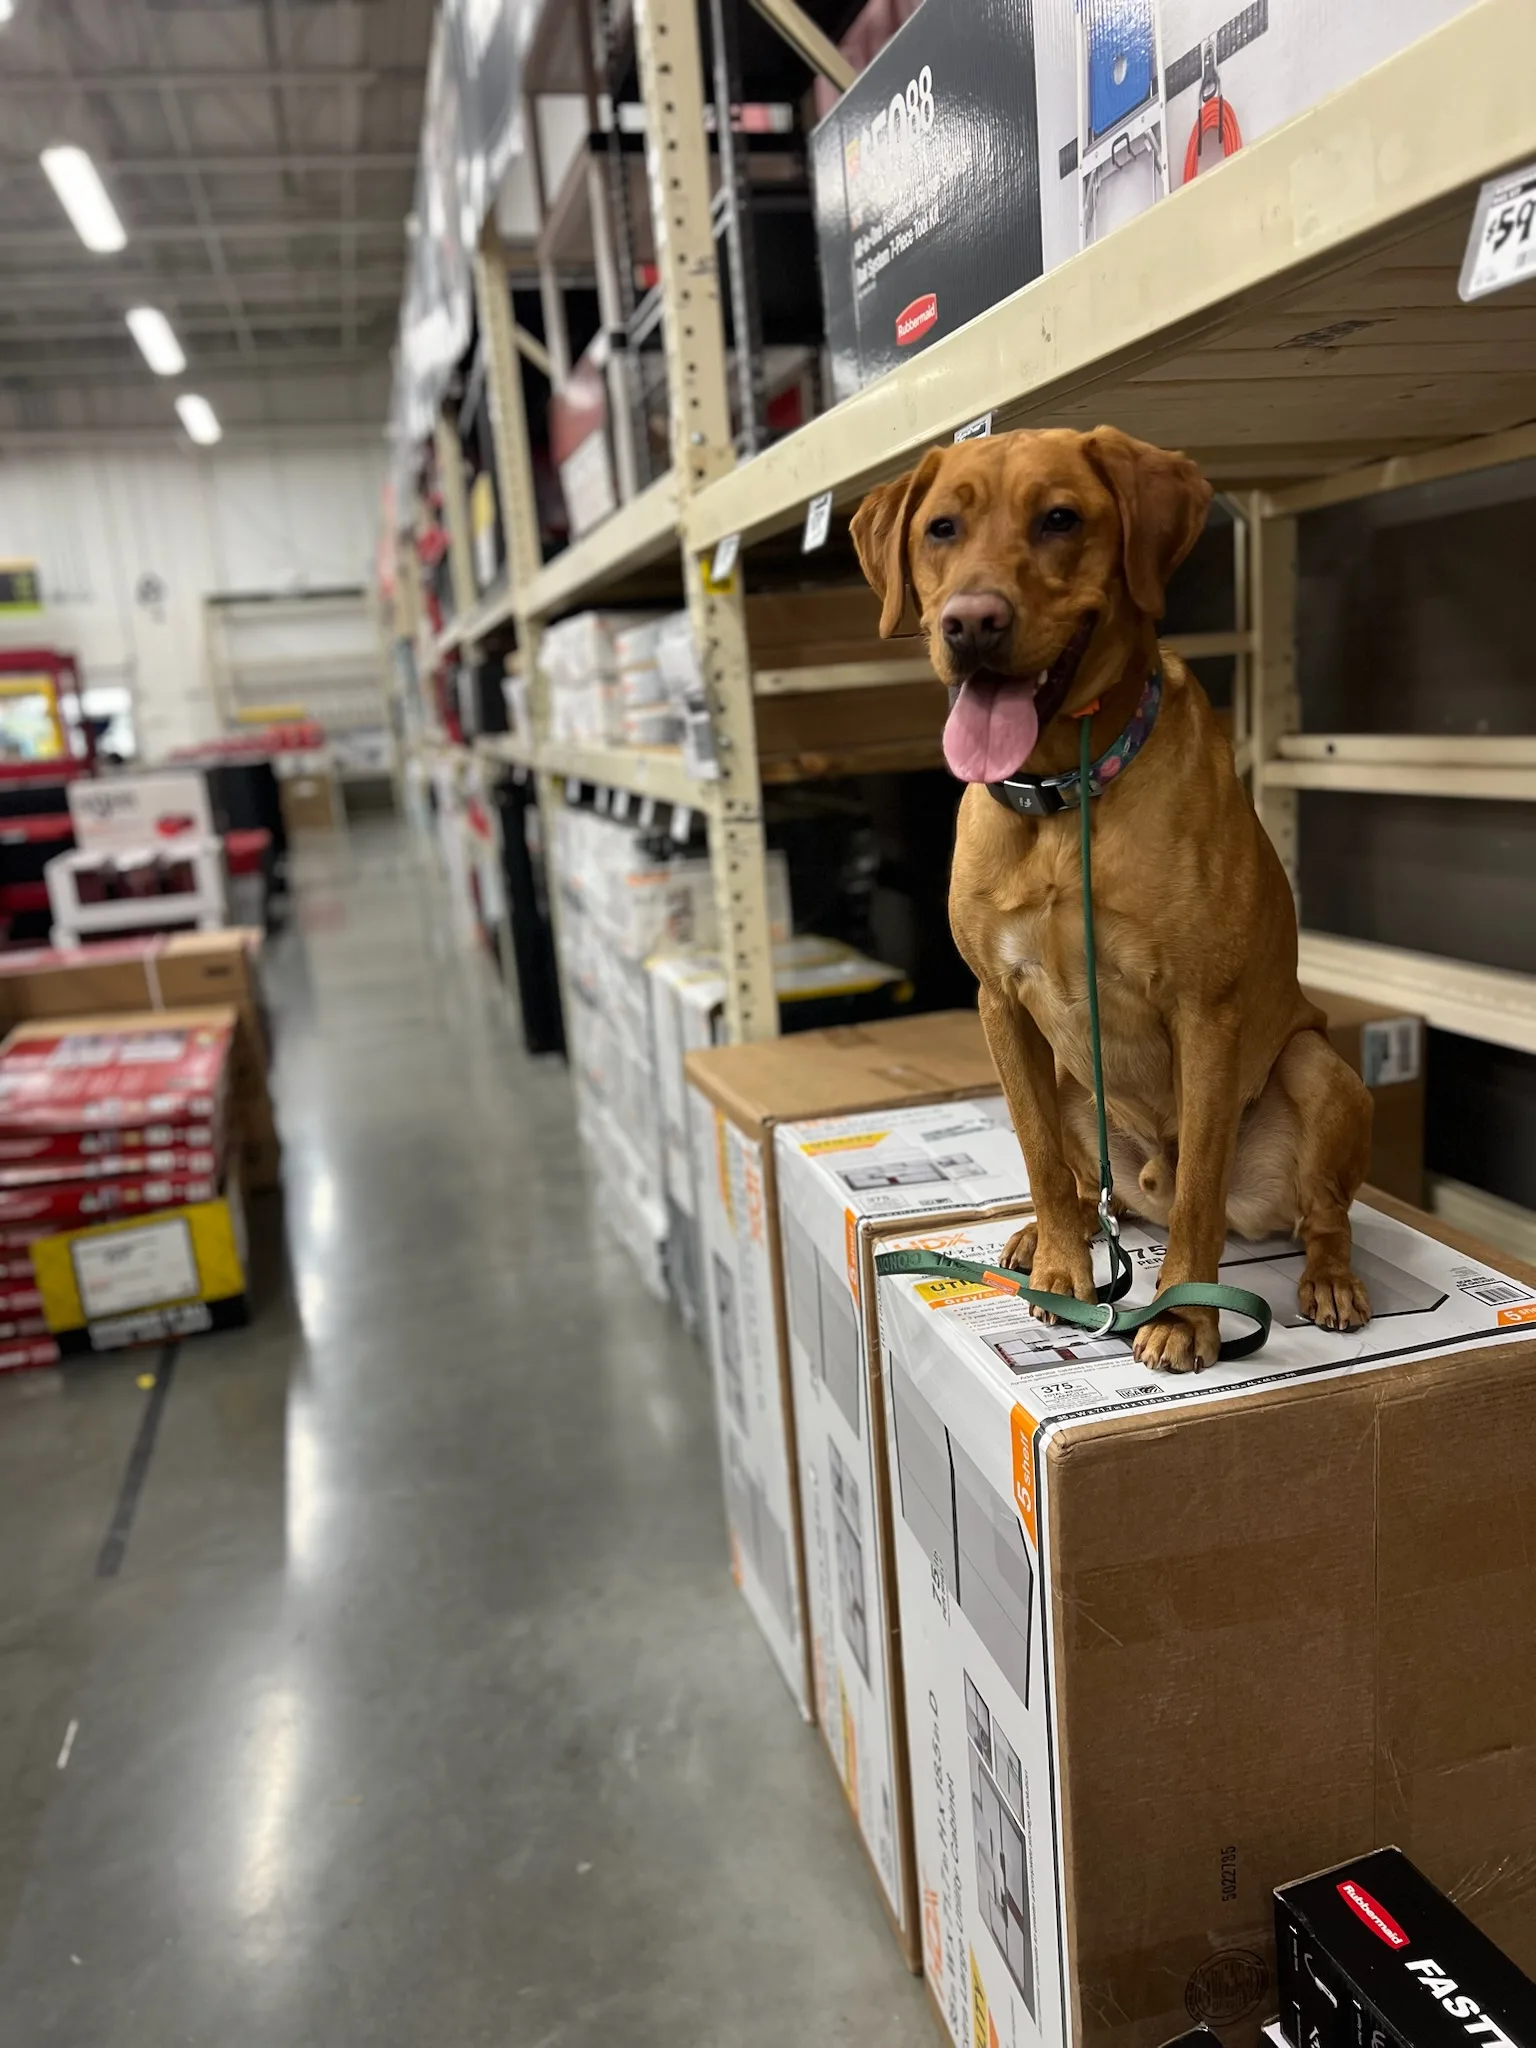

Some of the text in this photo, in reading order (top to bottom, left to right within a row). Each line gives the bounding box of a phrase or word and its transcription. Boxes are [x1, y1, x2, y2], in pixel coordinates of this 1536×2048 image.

[889, 228, 914, 260] 7-Piece
[913, 214, 929, 239] Tool
[897, 302, 936, 338] Rubbermaid
[966, 1243, 995, 1252] 71.7
[1127, 1245, 1168, 1259] 75
[930, 1280, 976, 1291] UTIL
[1504, 1307, 1536, 1321] 5 she
[1041, 1382, 1074, 1394] 375
[1017, 1430, 1031, 1512] 5 shelf
[929, 1689, 938, 1719] D
[946, 1772, 958, 1864] Cabinet
[953, 1868, 963, 1934] Utility
[1343, 1884, 1403, 1945] Rubbermaid
[974, 1986, 986, 2048] LITY
[1404, 1958, 1518, 2048] FASTT
